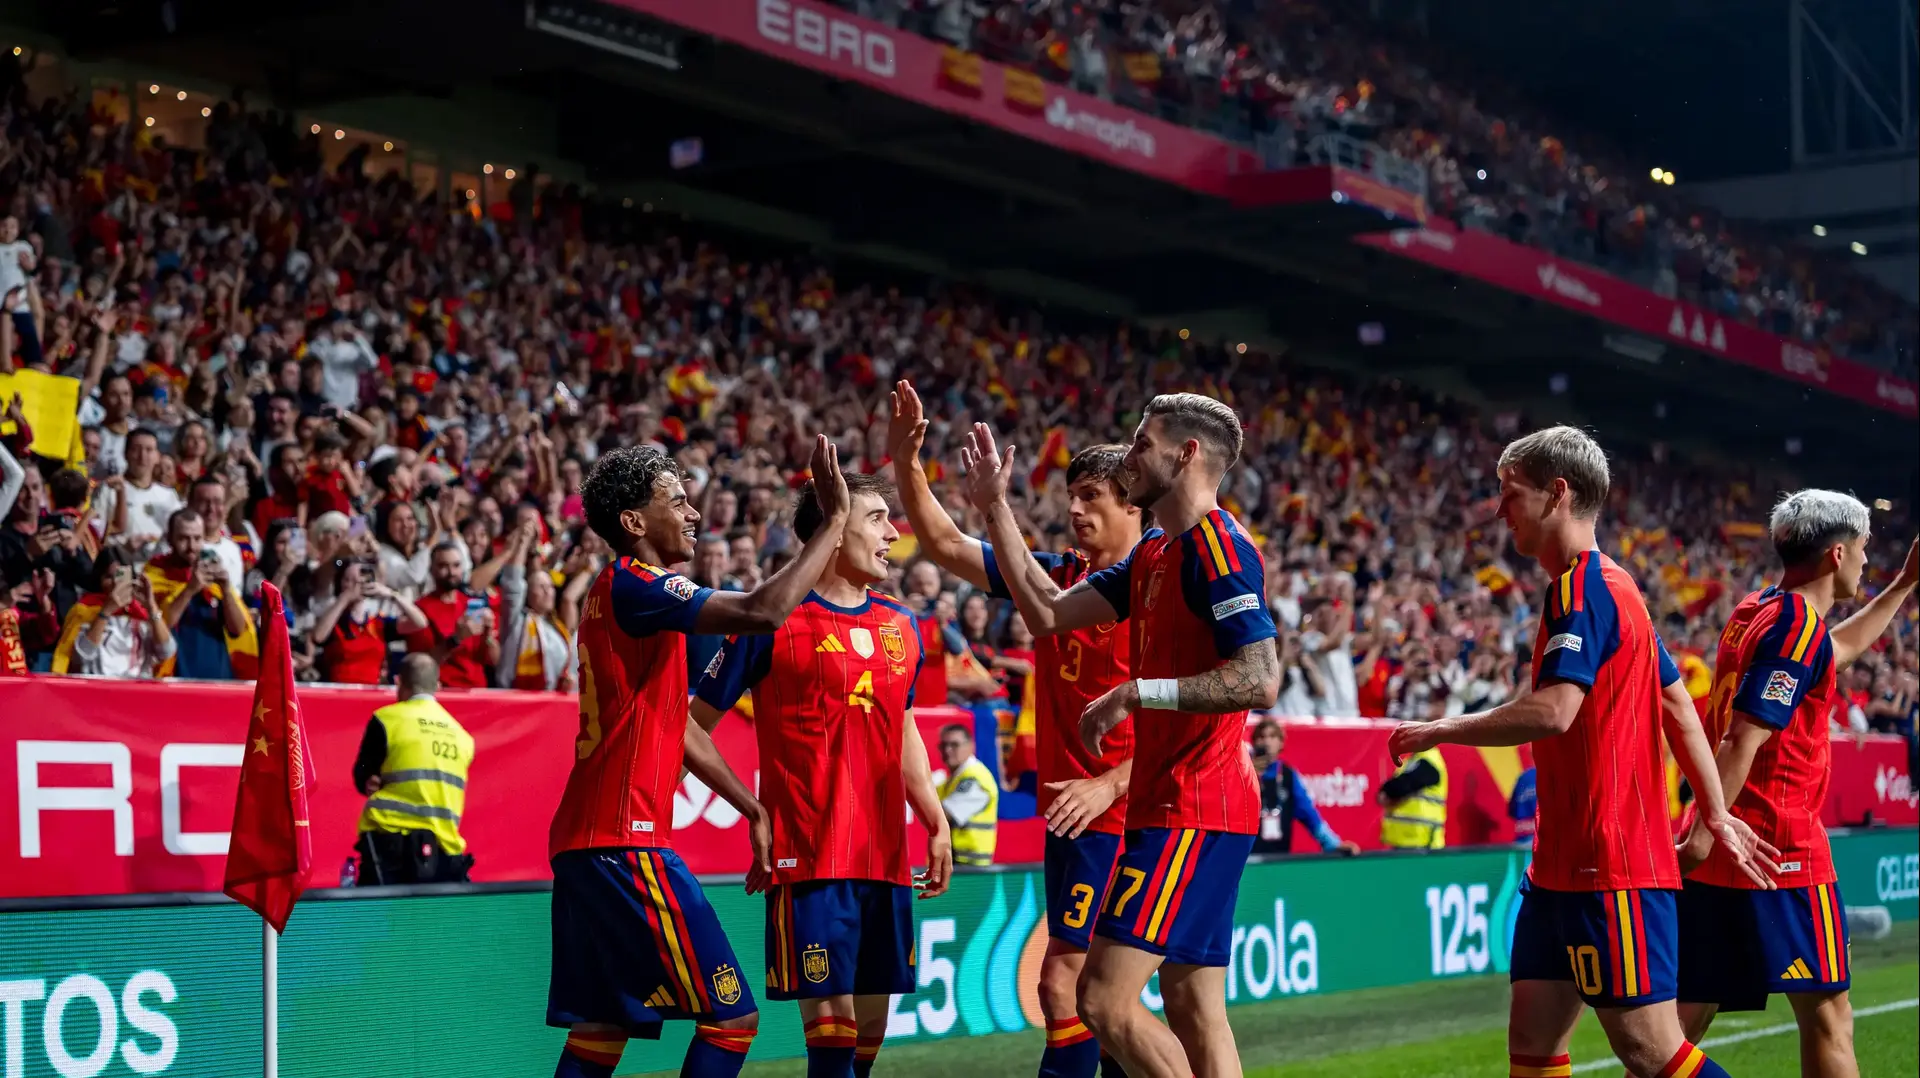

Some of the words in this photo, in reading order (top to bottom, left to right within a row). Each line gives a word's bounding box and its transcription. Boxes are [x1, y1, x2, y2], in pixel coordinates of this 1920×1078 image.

[757, 0, 896, 78] EBRO
[1060, 638, 1083, 682] 3
[848, 670, 875, 714] 4
[432, 740, 458, 761] 023
[1063, 883, 1095, 928] 3
[1101, 865, 1147, 917] 17
[1426, 883, 1490, 975] 125
[1567, 945, 1603, 995] 10
